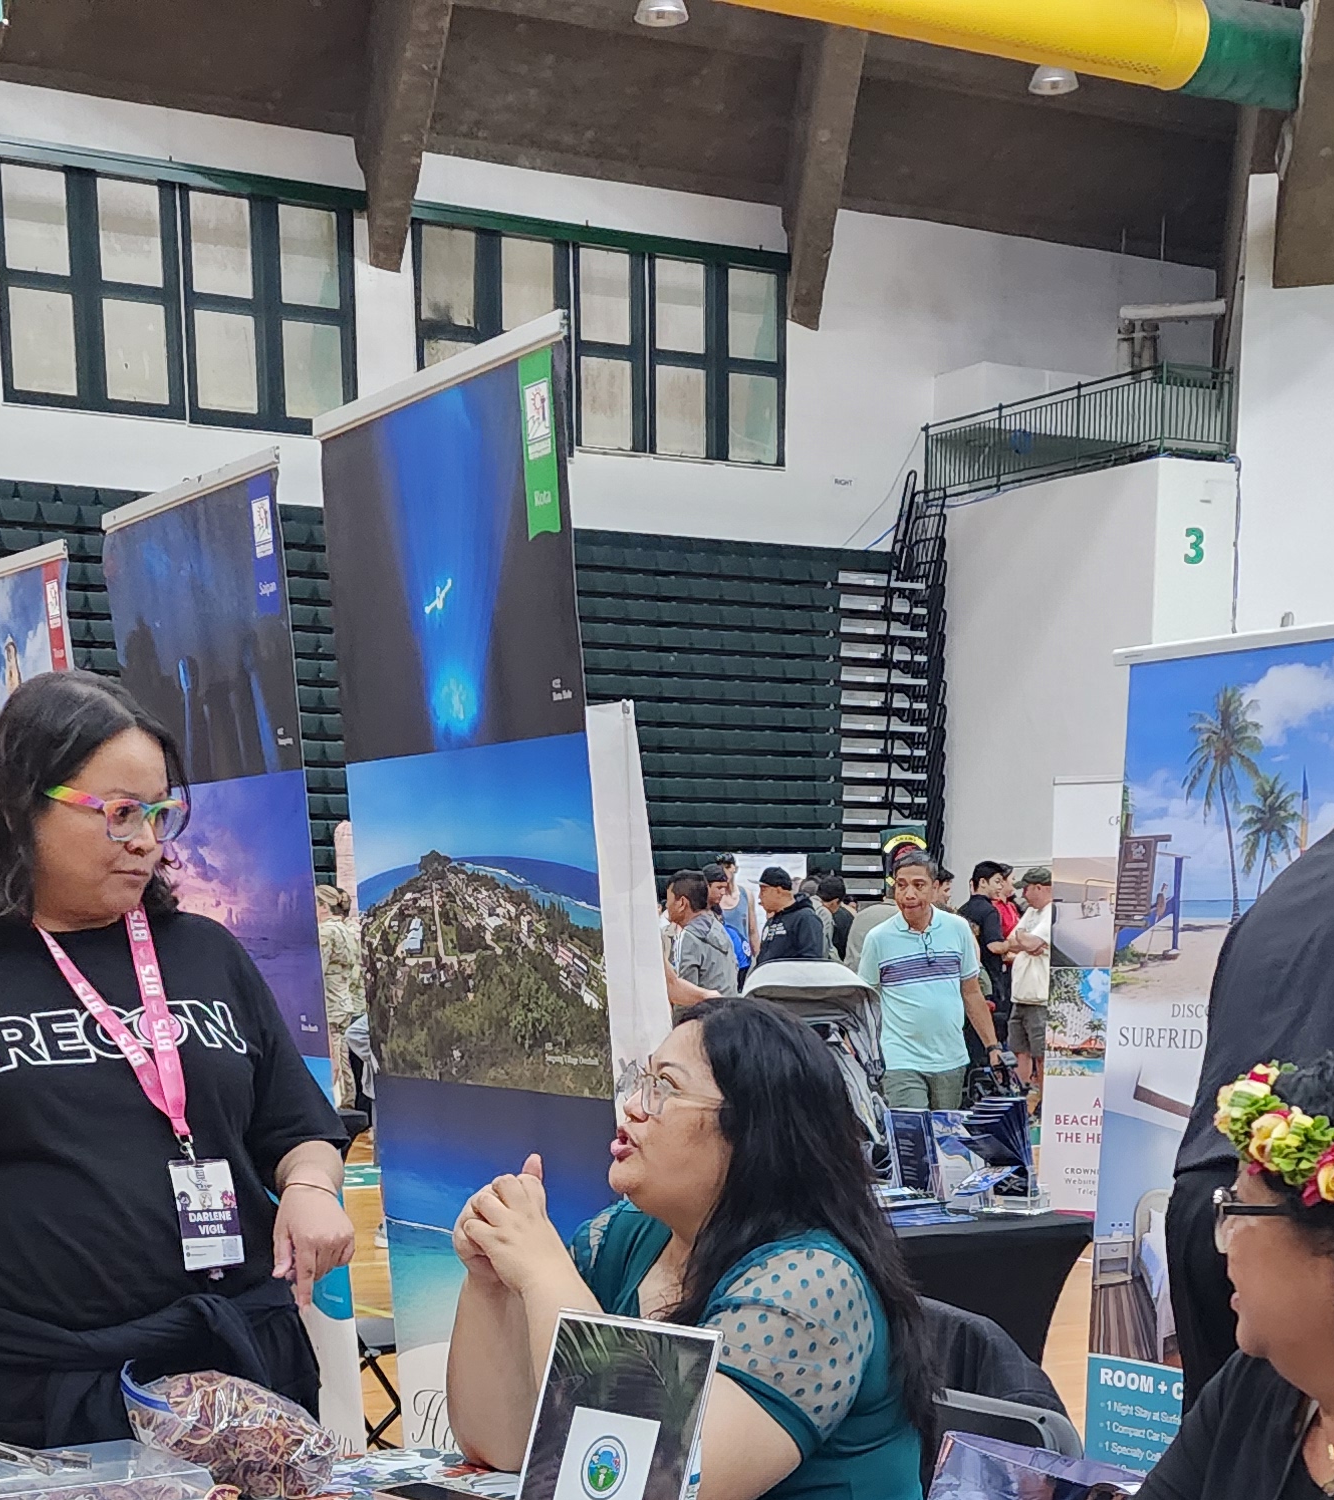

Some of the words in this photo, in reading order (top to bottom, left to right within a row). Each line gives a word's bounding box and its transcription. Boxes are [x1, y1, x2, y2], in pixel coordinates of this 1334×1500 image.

[1184, 527, 1205, 565] 3
[129, 909, 148, 941] BTS
[140, 964, 161, 996] BTS
[76, 981, 105, 1014] BTS
[117, 1032, 147, 1068] BTS
[154, 1019, 174, 1052] BTS
[1056, 1132, 1082, 1144] THE
[188, 1211, 232, 1223] DARLENE
[198, 1224, 226, 1235] VIGIL
[1100, 1368, 1154, 1394] ROOM
[1113, 1401, 1134, 1416] Night
[1134, 1406, 1151, 1420] Stay
[1112, 1422, 1146, 1437] Compact
[1147, 1428, 1160, 1441] Car
